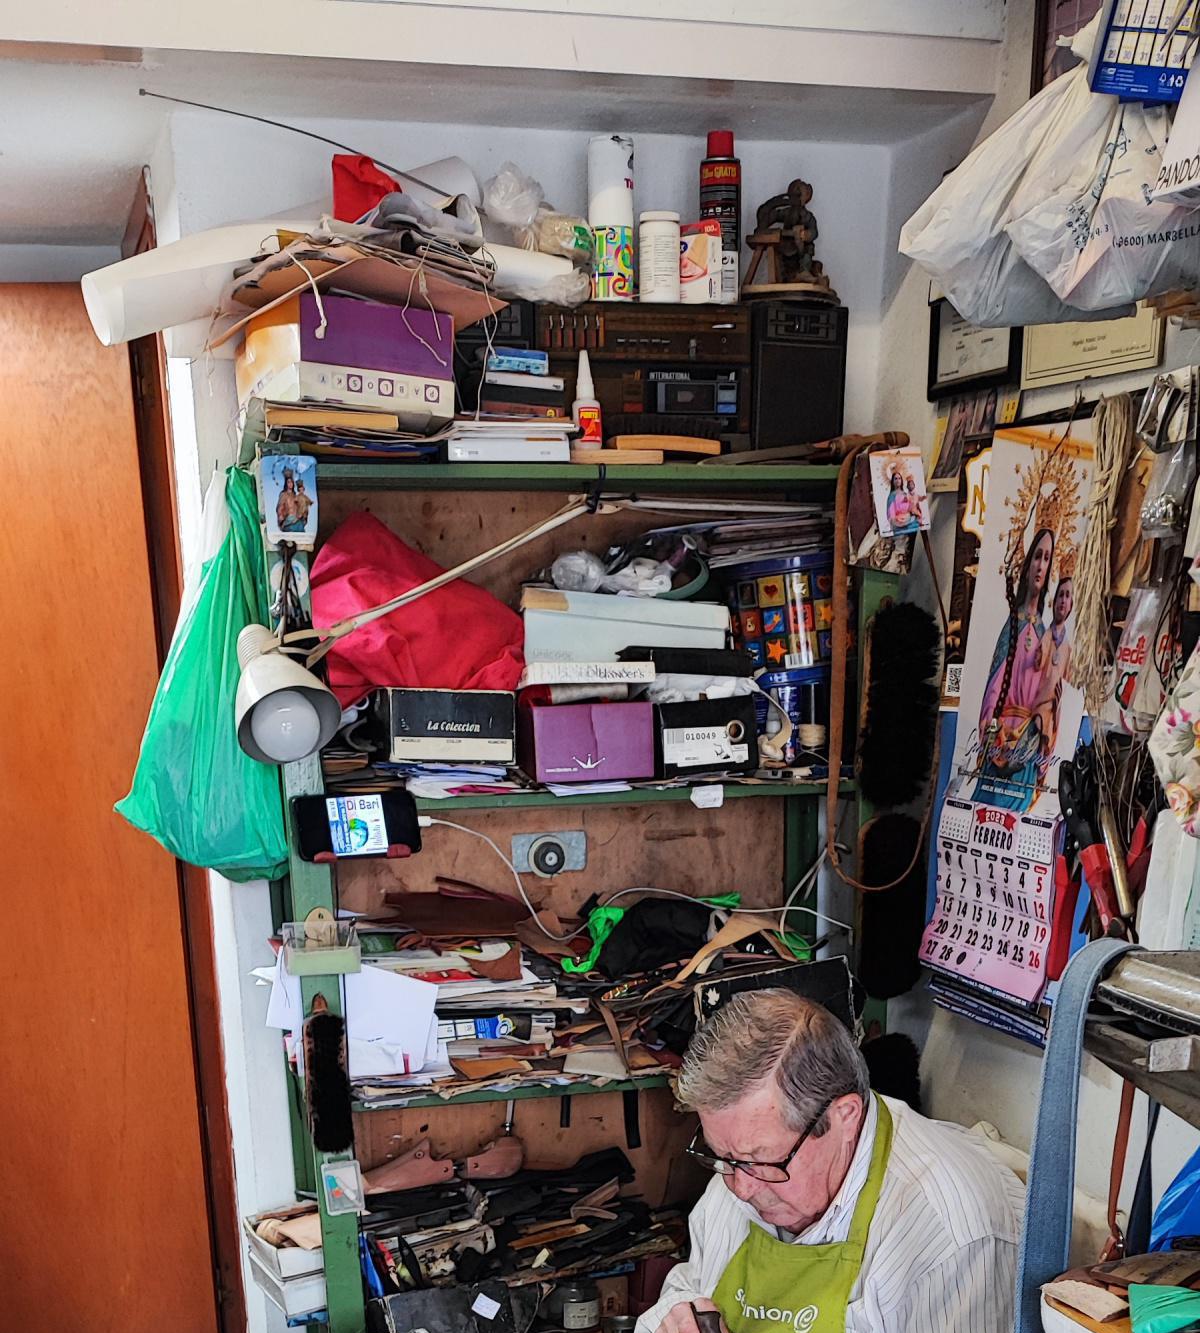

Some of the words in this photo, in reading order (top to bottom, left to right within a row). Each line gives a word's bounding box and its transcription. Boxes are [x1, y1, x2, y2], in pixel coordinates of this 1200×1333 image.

[649, 371, 691, 381] INTERNATIONAL
[427, 720, 439, 731] La
[685, 732, 717, 741] 010049
[346, 800, 357, 811] Di
[358, 798, 380, 810] Bari
[985, 811, 1006, 825] 2023
[973, 824, 1014, 851] FEBRERO
[988, 862, 994, 879] 2
[1003, 867, 1009, 884] 3
[1019, 871, 1025, 889] 4
[1036, 876, 1043, 893] 5
[945, 873, 952, 889] 6
[960, 878, 967, 893] 7
[975, 882, 982, 899] 8
[990, 885, 997, 903] 9
[1003, 890, 1014, 908] 10
[1017, 896, 1029, 914] 11
[1033, 901, 1045, 920] 12
[942, 895, 954, 913] 13
[956, 900, 968, 918] 14
[972, 905, 983, 923] 15
[986, 910, 997, 927] 16
[1001, 915, 1014, 932] 17
[1017, 920, 1030, 938] 18
[1033, 925, 1047, 944] 19
[925, 939, 938, 956] 27
[938, 944, 953, 961] 28
[934, 918, 949, 935] 20
[949, 923, 963, 940] 21
[965, 928, 979, 946] 22
[980, 934, 993, 952] 23
[996, 939, 1008, 958] 24
[1012, 944, 1024, 963] 25
[1028, 950, 1040, 969] 26
